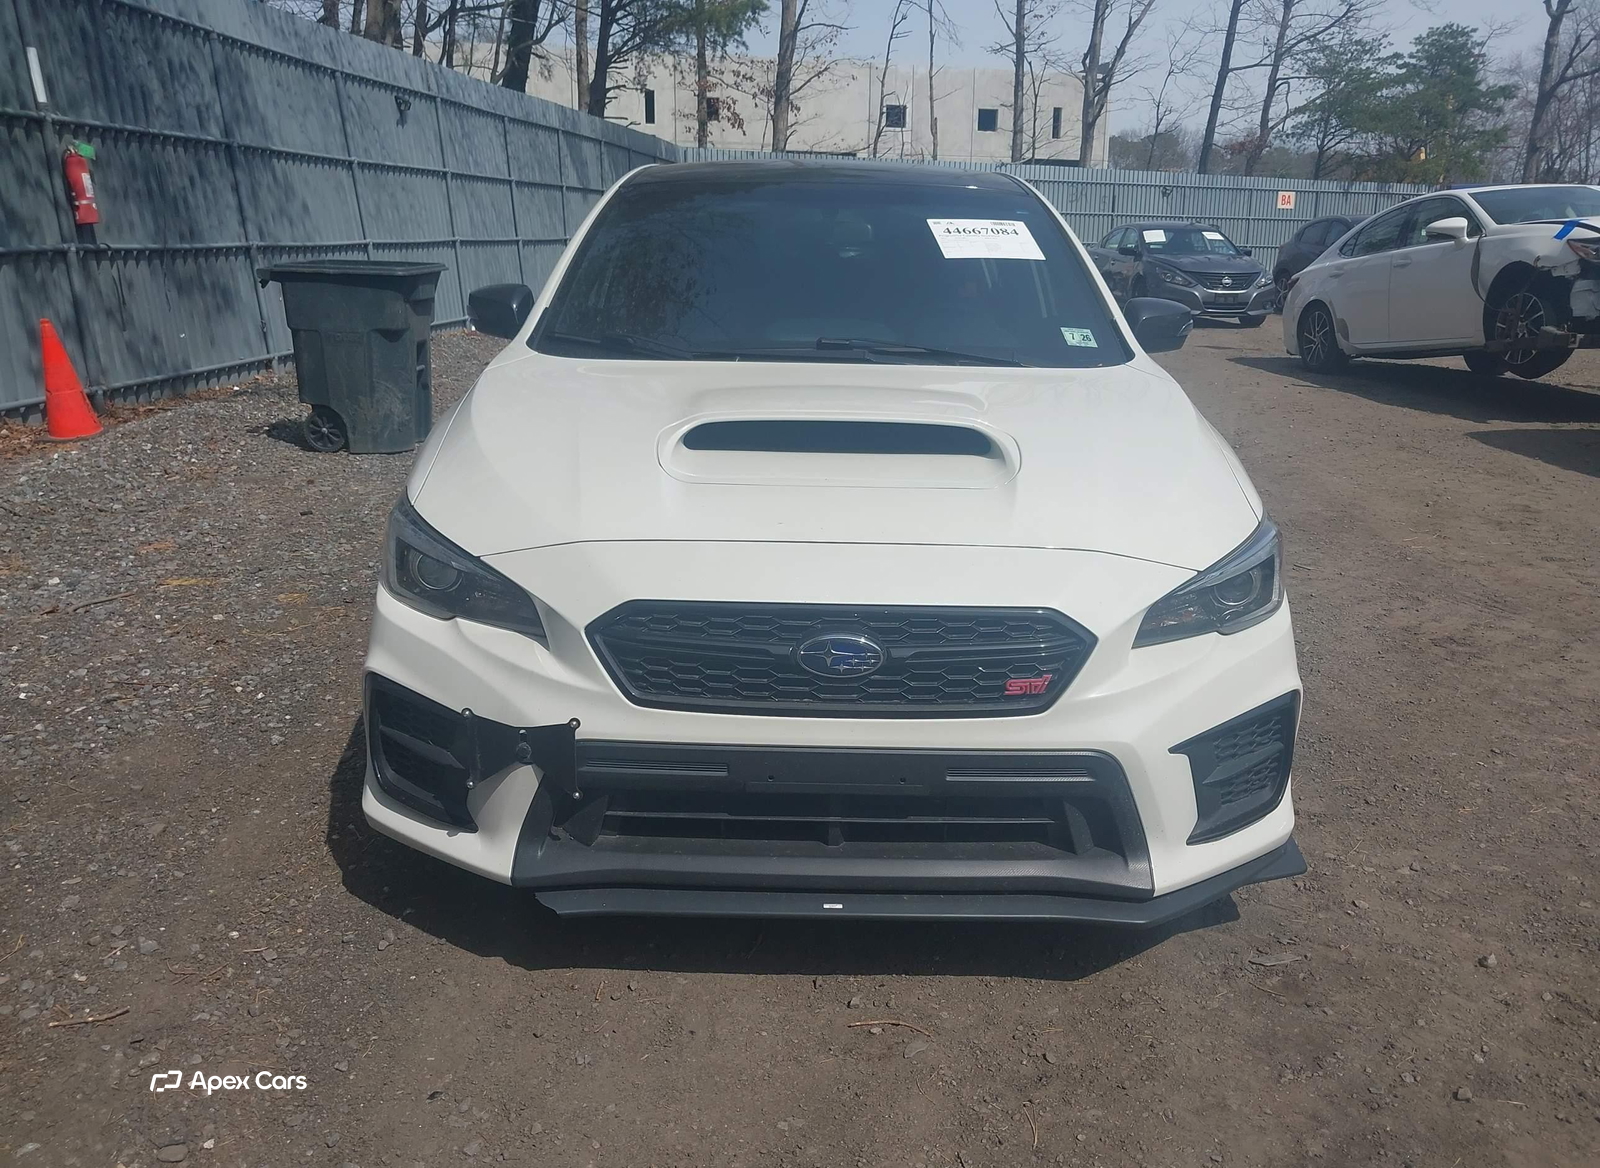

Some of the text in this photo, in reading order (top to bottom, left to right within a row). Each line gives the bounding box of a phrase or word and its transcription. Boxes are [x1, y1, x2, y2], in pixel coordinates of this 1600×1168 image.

[1281, 194, 1291, 206] BA
[943, 227, 1019, 236] 44667084
[1069, 332, 1092, 342] 7 26
